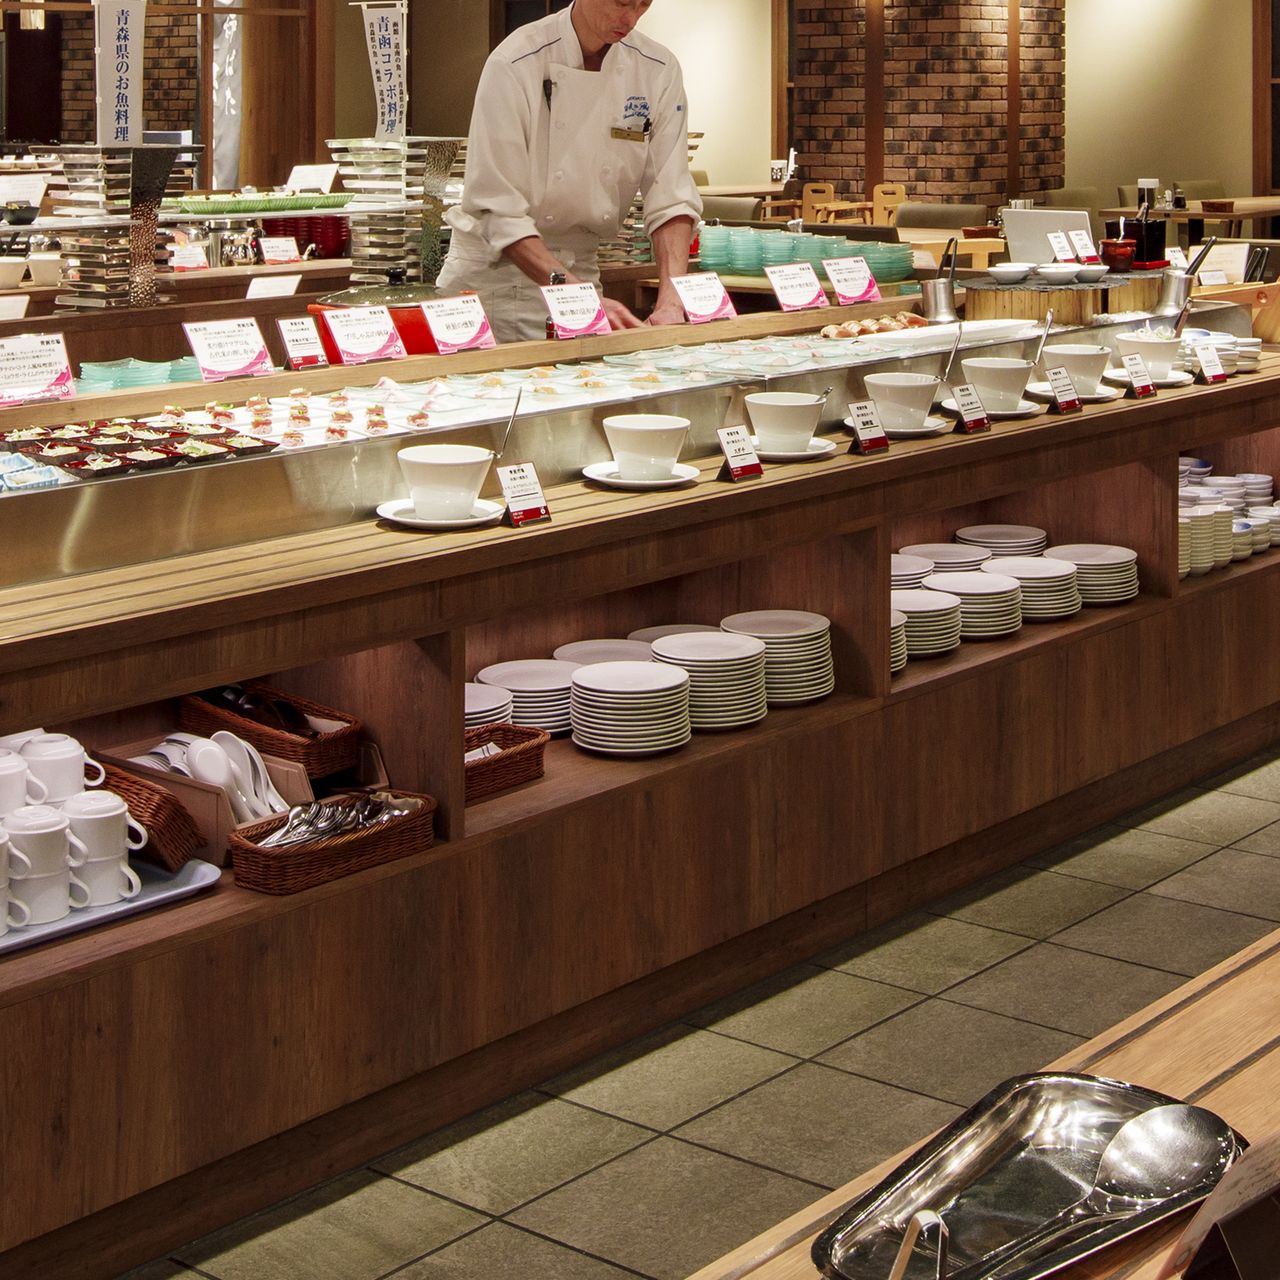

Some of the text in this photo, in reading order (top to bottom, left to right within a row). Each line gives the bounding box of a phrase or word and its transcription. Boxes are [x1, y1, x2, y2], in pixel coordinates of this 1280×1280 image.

[114, 9, 130, 142] 青森県のお魚料理
[377, 16, 398, 134] 青函コラボ料理
